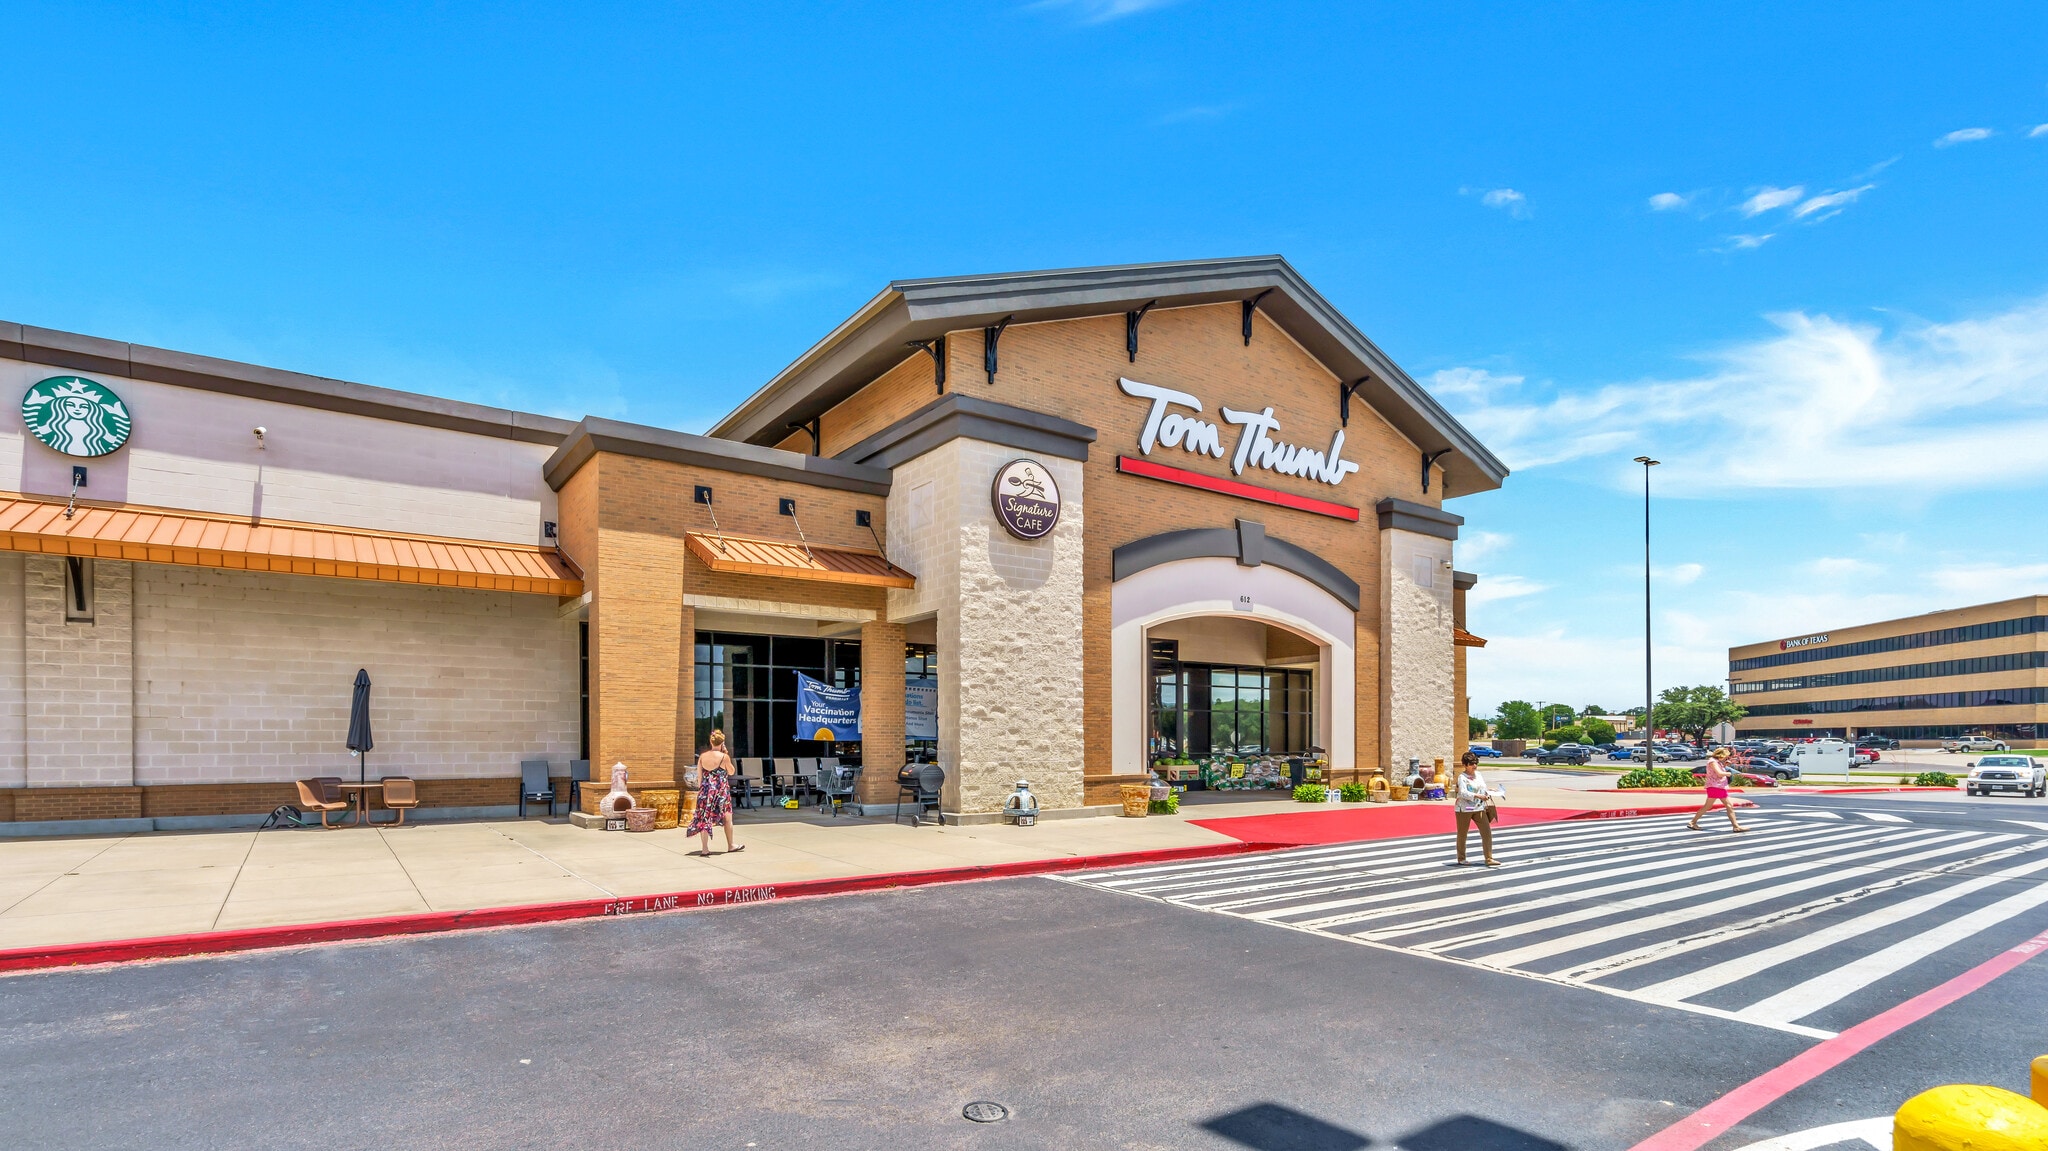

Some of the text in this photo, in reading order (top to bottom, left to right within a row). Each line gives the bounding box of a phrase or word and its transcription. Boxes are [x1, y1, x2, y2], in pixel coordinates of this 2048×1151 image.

[1116, 376, 1360, 486] Tom Thumb
[1005, 497, 1054, 517] Signature
[1016, 517, 1042, 531] CAFE
[1239, 595, 1251, 603] 612
[1787, 640, 1801, 648] BANK
[1810, 635, 1828, 644] TEXAS
[806, 680, 851, 695] Tom Thumb
[905, 692, 924, 700] ations
[804, 705, 855, 716] Vaccination
[798, 713, 857, 725] Headquarters
[644, 896, 679, 912] LANE
[697, 891, 714, 906] NO
[725, 886, 776, 904] PARKING
